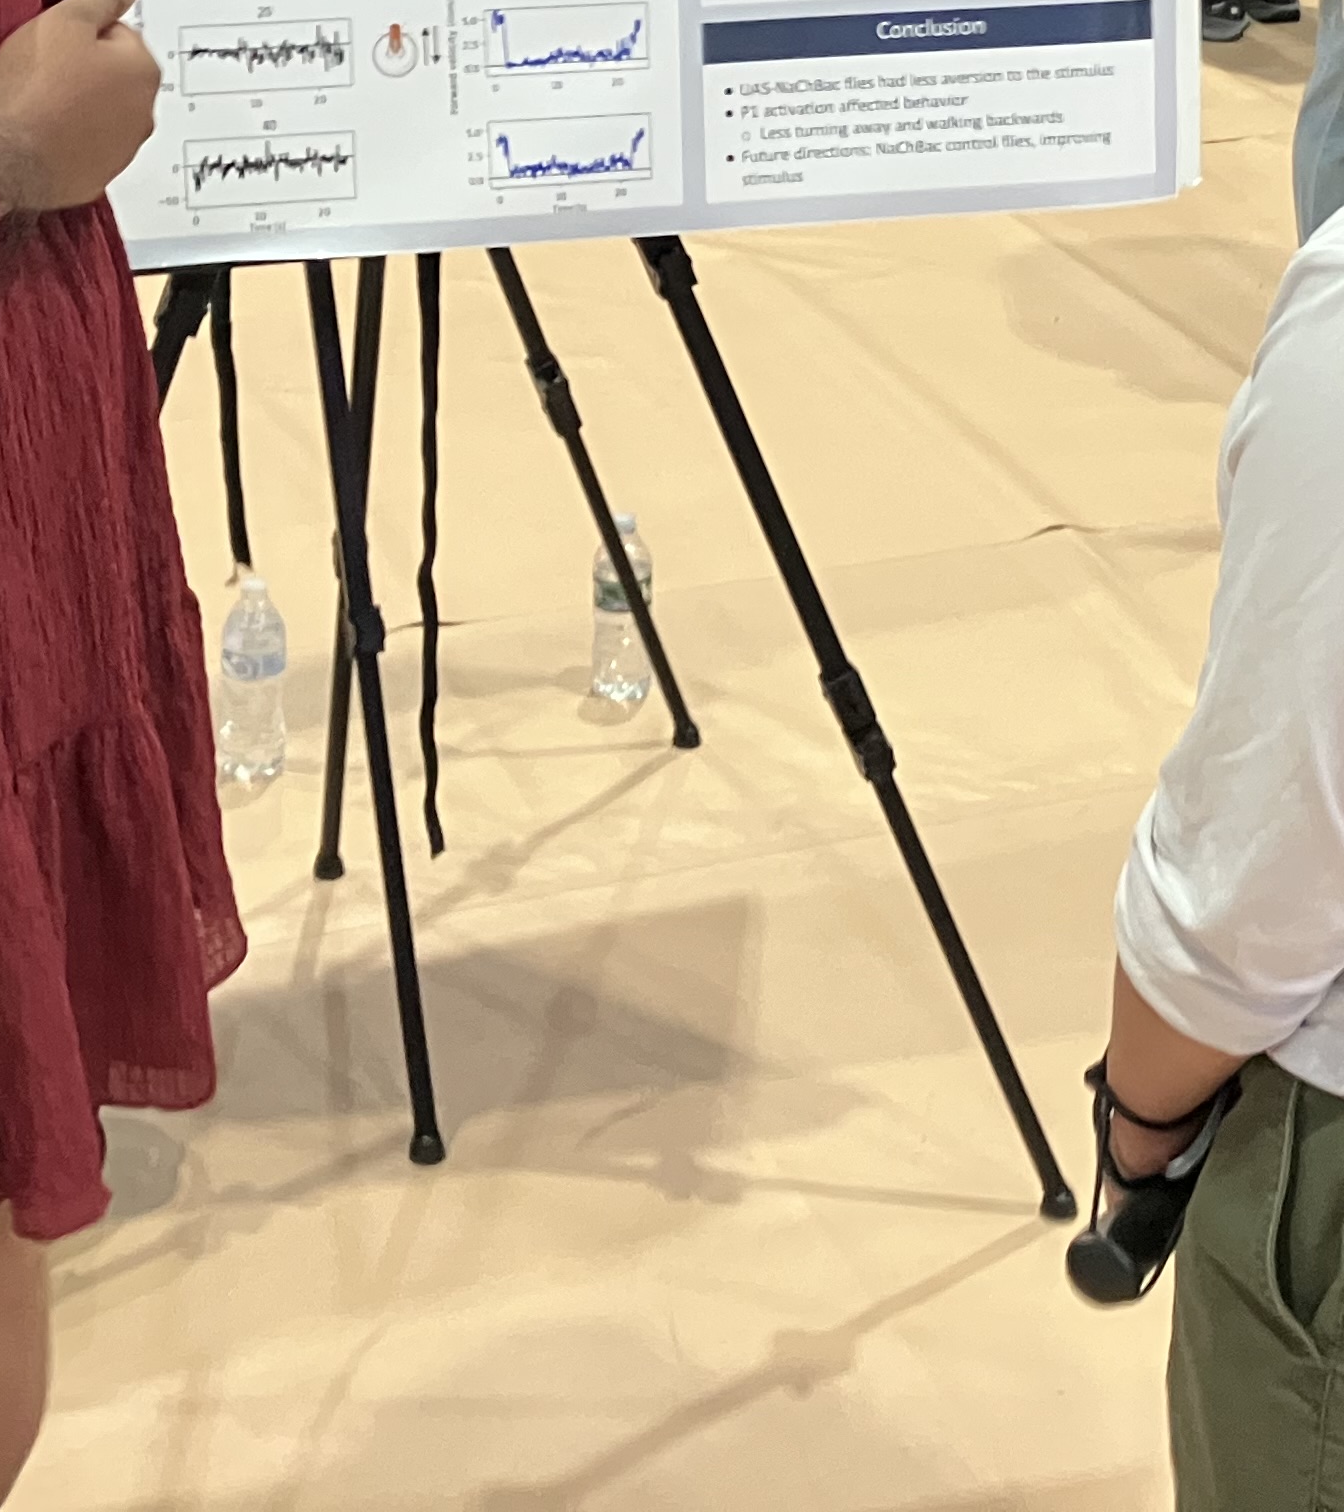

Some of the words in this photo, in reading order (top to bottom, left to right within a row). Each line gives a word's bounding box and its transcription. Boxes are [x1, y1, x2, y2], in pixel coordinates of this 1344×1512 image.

[876, 18, 987, 40] Conclusion
[877, 74, 906, 88] had
[941, 71, 1002, 86] aversion
[1054, 64, 1115, 80] stimulus
[895, 118, 923, 132] and
[926, 115, 983, 131] walking
[986, 111, 1065, 127] backwards
[945, 136, 998, 152] control
[1040, 131, 1112, 151] improving
[742, 171, 804, 187] stimulus
